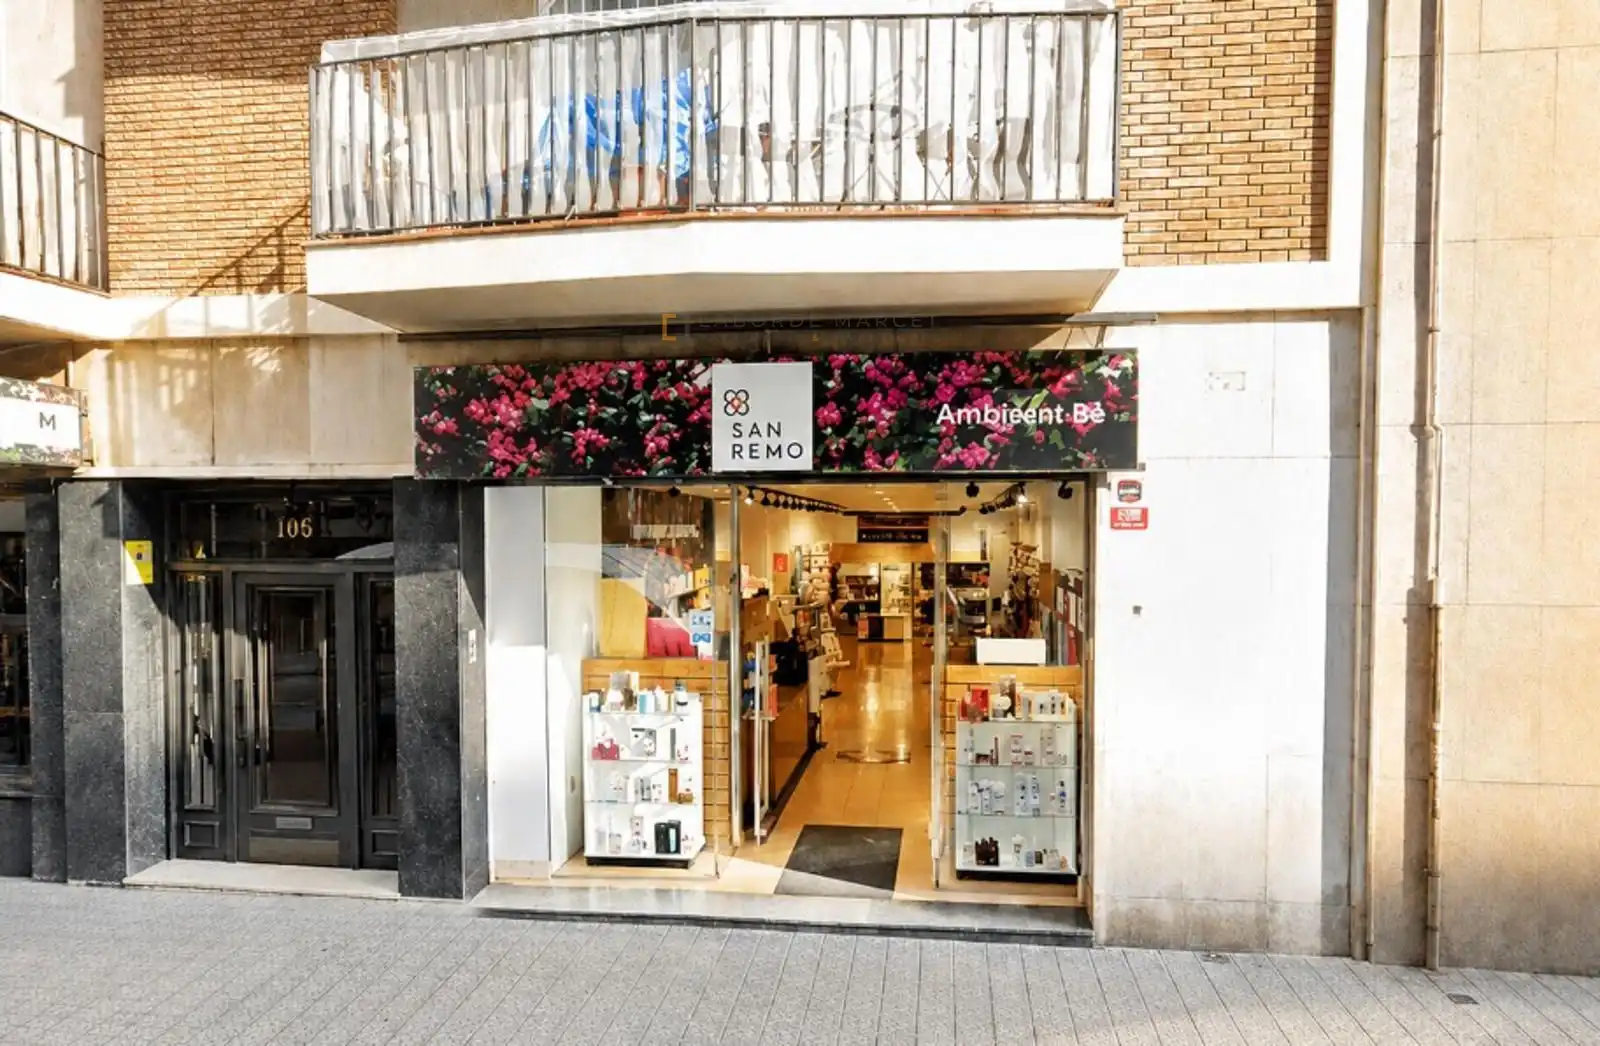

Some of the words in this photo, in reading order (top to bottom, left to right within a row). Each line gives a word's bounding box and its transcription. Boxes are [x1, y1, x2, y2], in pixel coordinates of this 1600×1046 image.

[39, 411, 56, 431] M
[732, 421, 782, 439] SAN
[731, 442, 804, 460] REMO
[276, 516, 313, 539] 106
